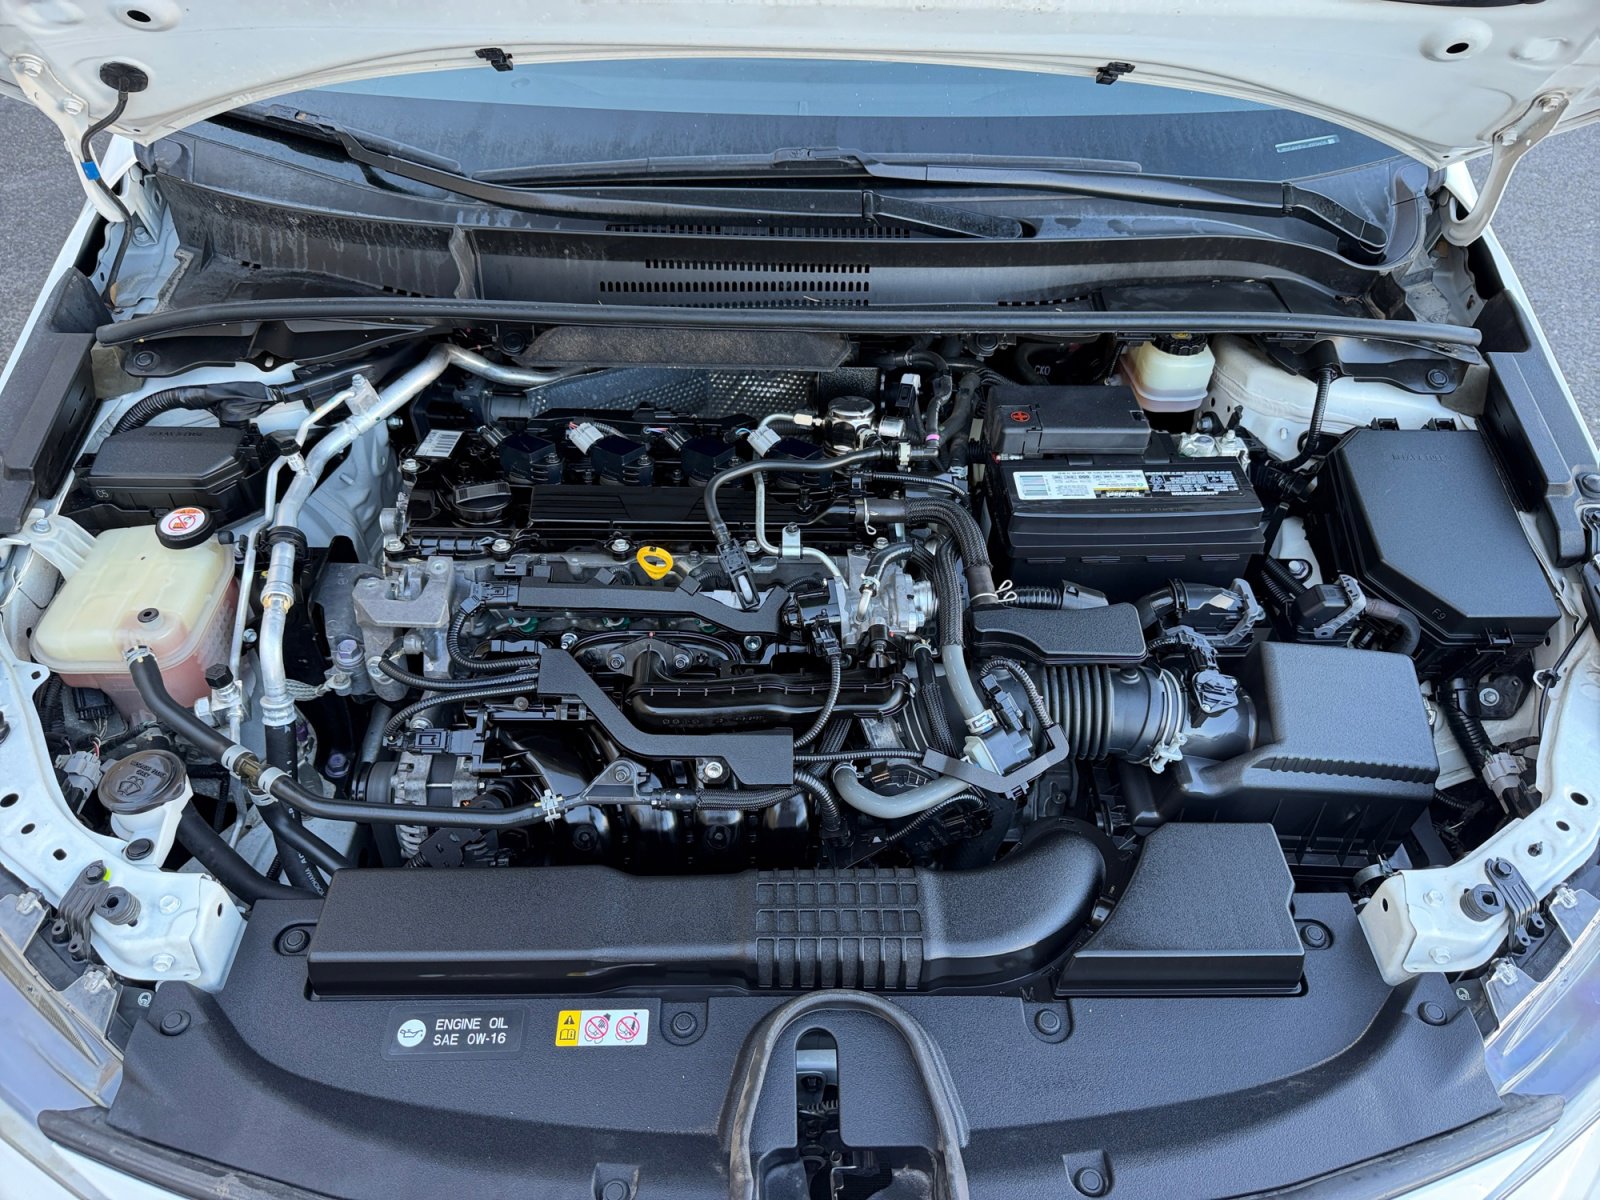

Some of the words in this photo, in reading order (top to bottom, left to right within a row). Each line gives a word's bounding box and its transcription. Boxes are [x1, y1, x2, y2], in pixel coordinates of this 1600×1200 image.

[1431, 608, 1447, 620] F9
[435, 1018, 481, 1031] ENGINE
[489, 1017, 509, 1029] OIL
[433, 1033, 460, 1046] SAE
[467, 1032, 507, 1045] 0W-16
